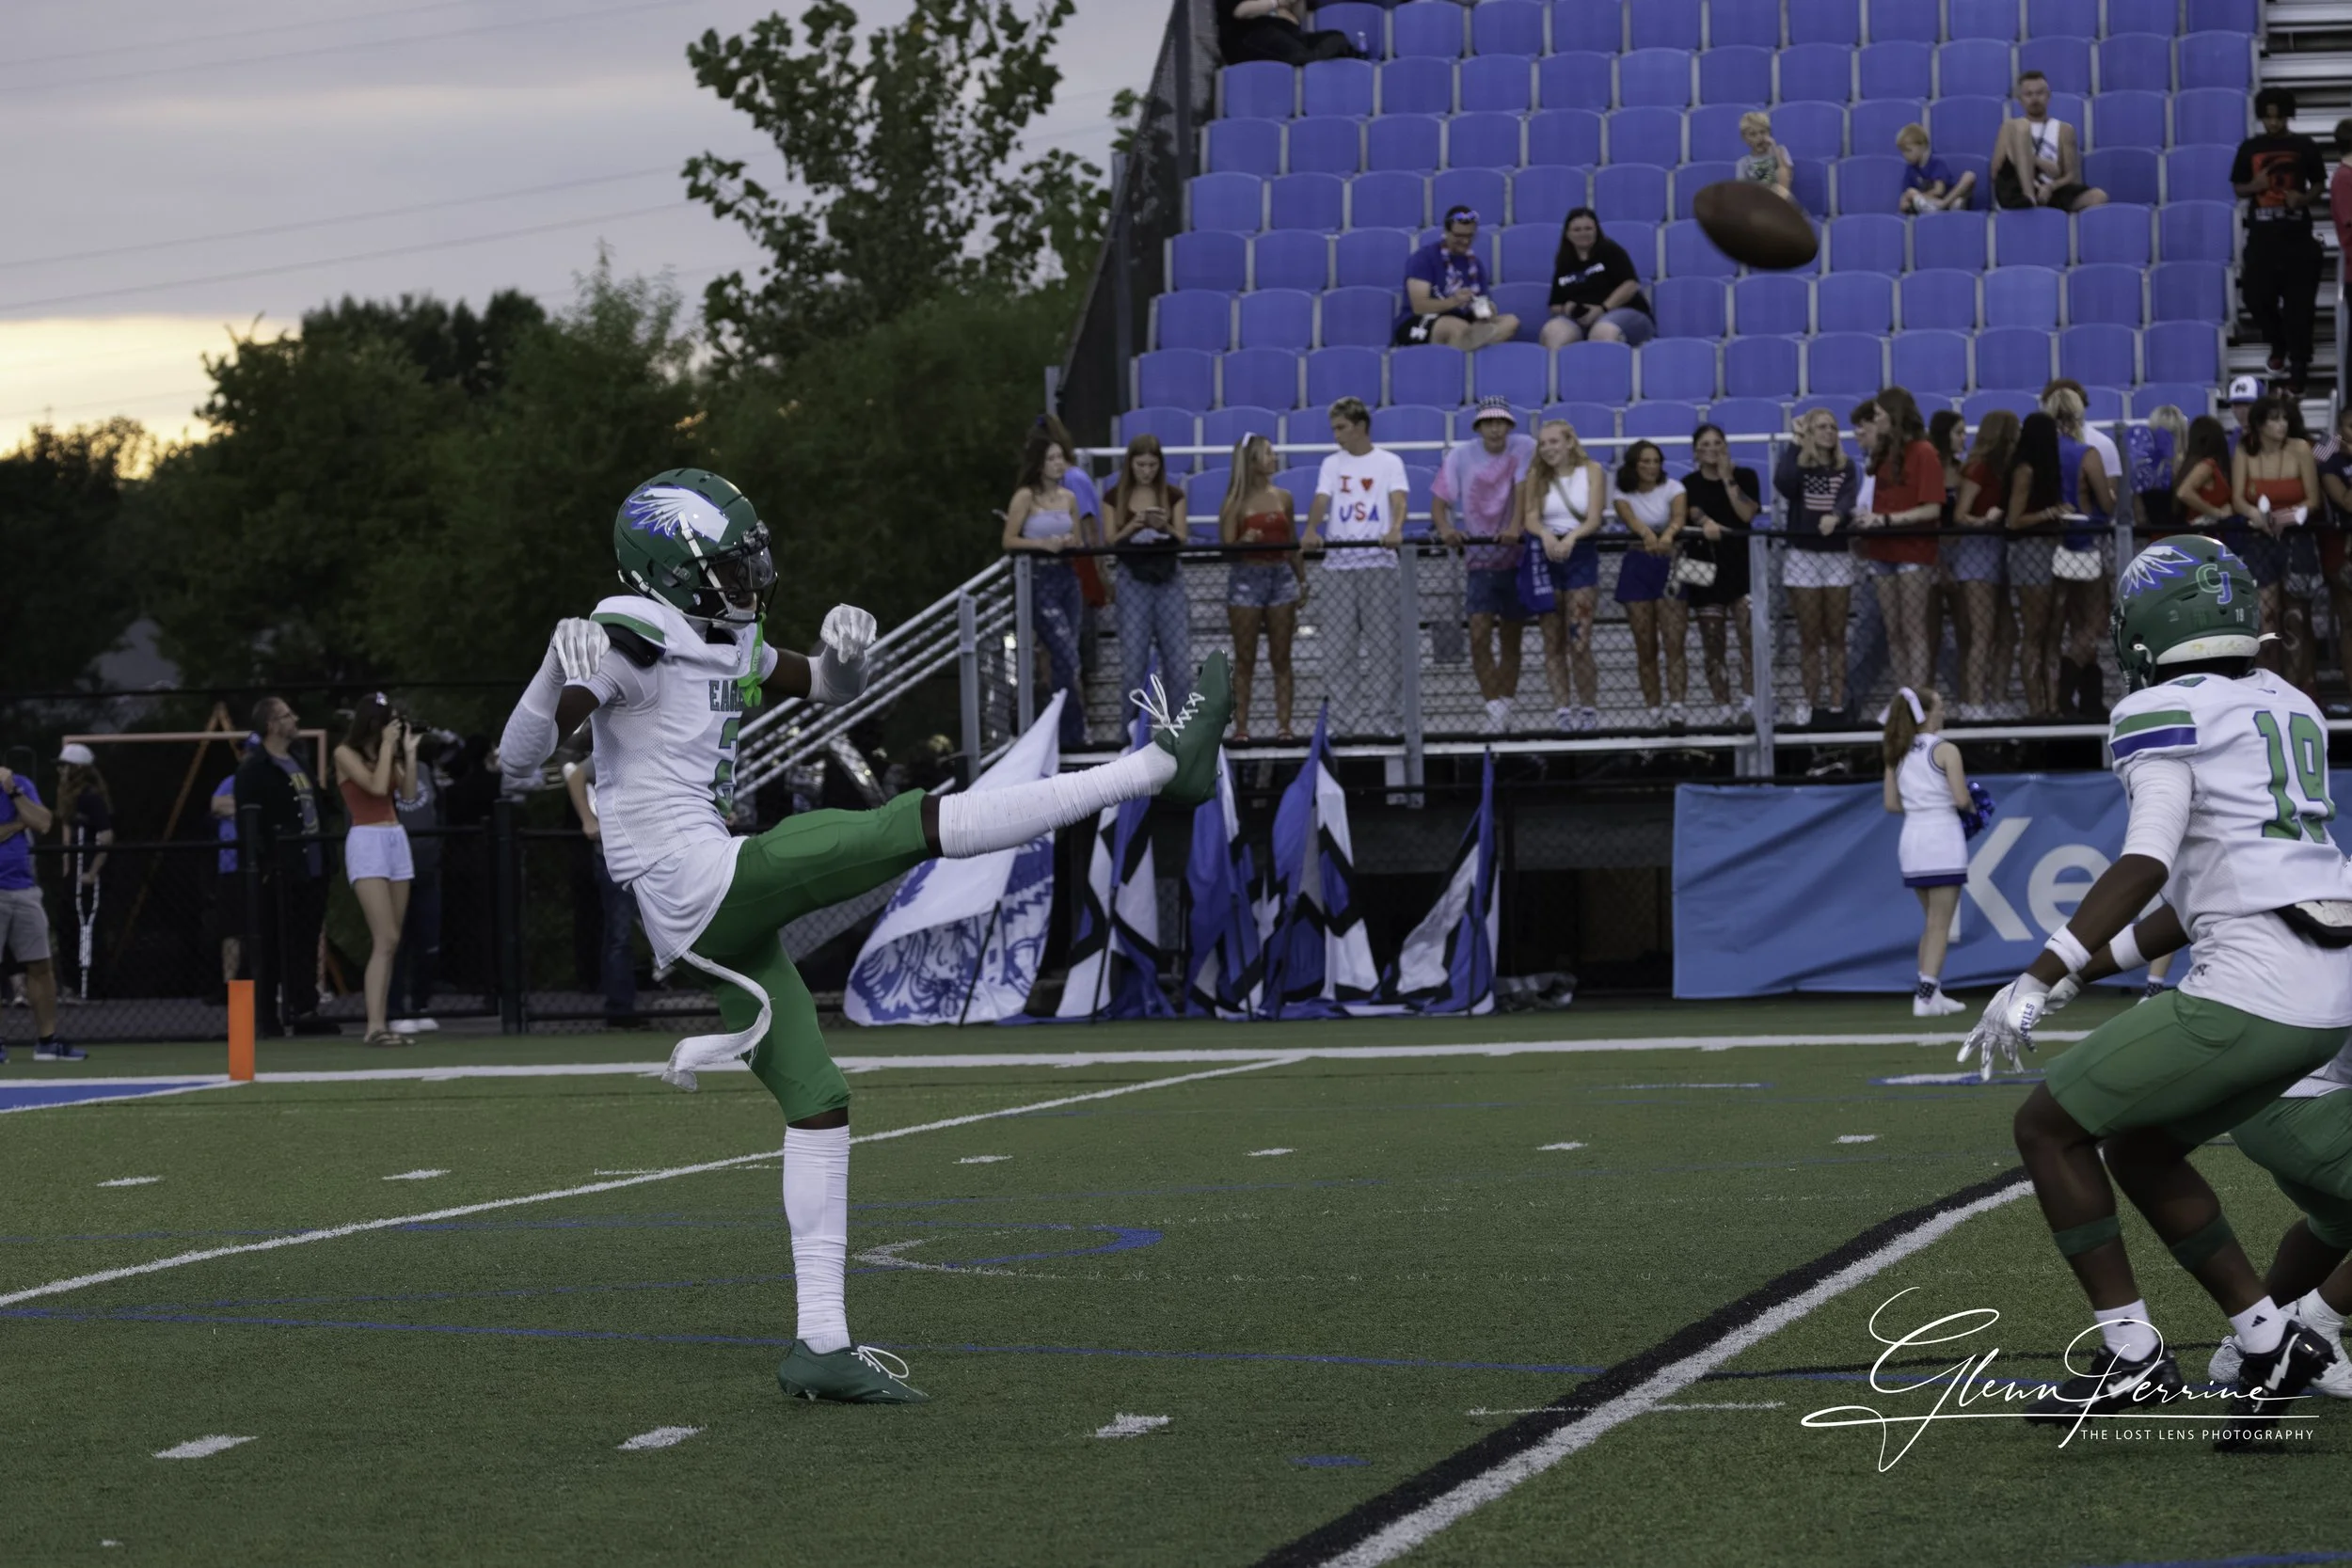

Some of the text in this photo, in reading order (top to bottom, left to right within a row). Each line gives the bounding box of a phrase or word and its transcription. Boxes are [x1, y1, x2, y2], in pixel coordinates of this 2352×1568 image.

[1340, 475, 1352, 493] I
[1340, 501, 1380, 522] USA
[2195, 563, 2233, 604] CJ
[2252, 710, 2336, 844] 19
